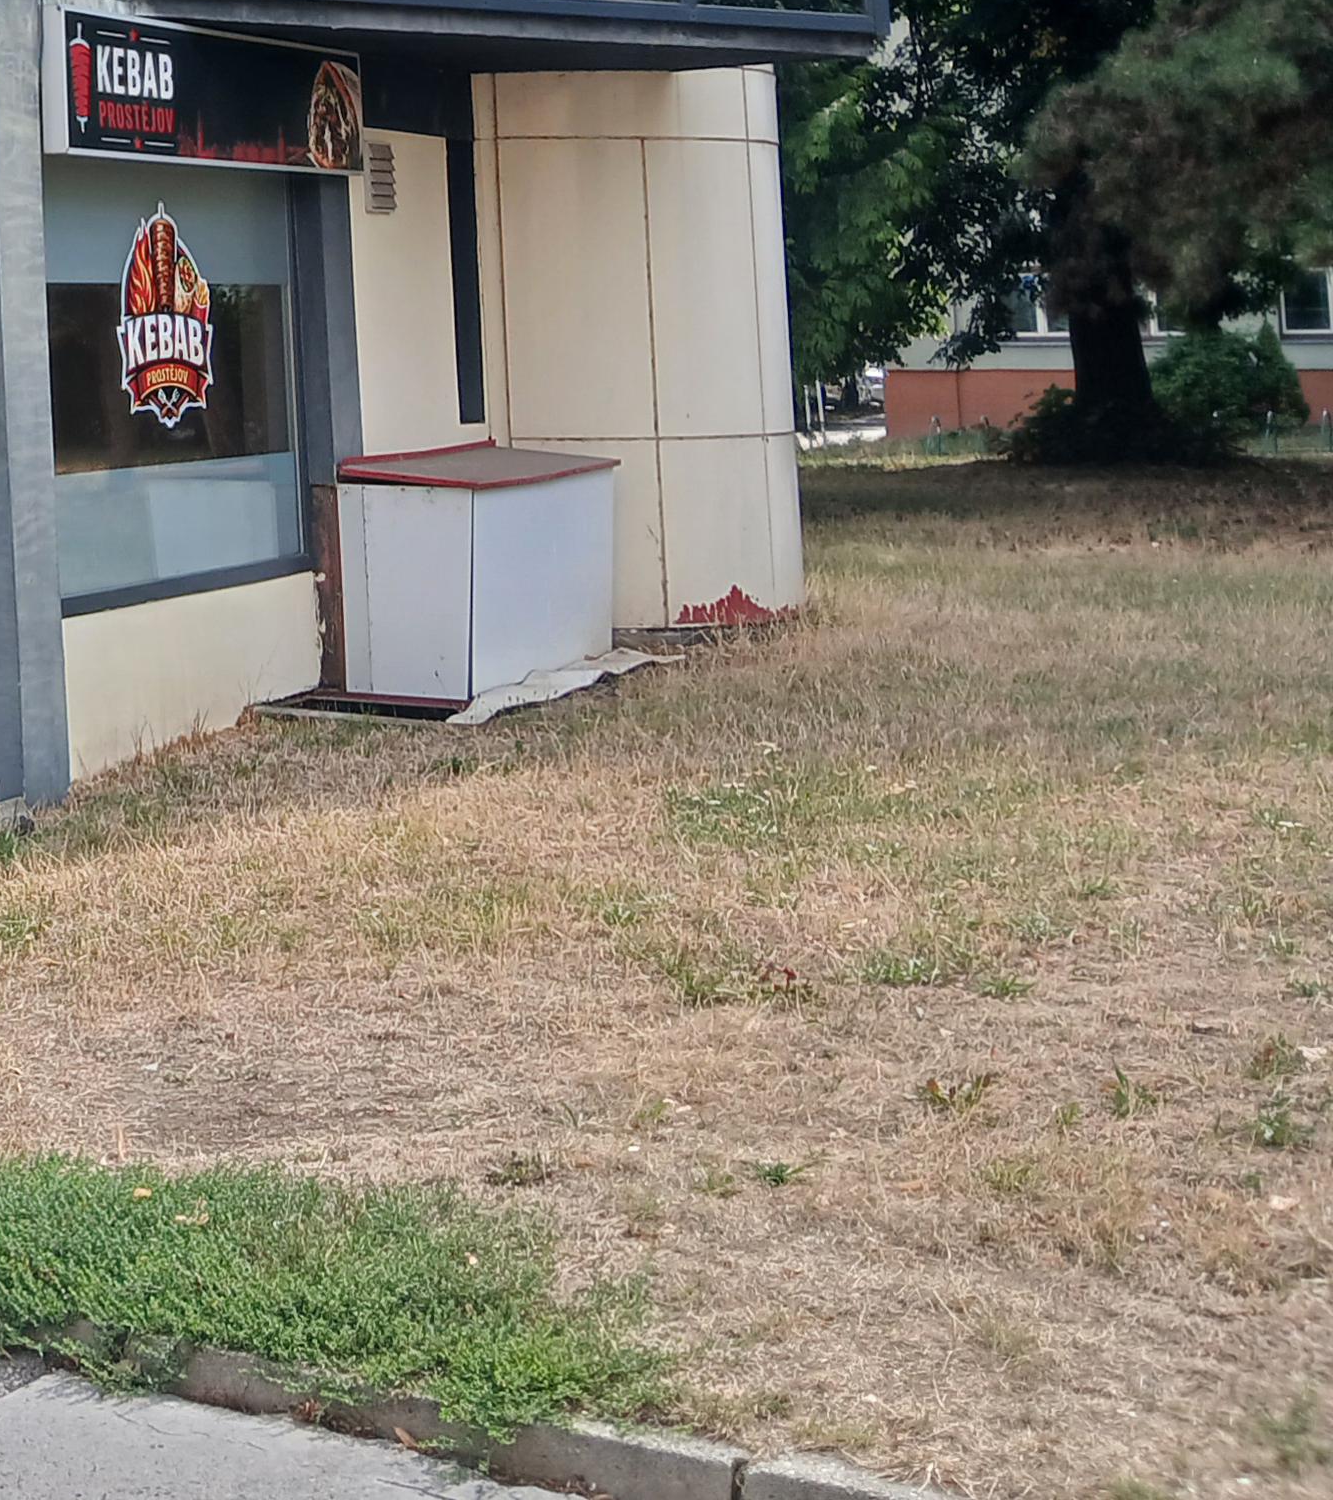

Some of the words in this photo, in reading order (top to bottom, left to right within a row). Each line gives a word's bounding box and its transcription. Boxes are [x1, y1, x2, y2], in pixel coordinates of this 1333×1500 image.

[96, 44, 174, 100] KEBAB
[98, 100, 175, 133] PROSTĚJOV
[126, 314, 204, 370] KEBAB
[146, 364, 189, 386] PROSTĚJOV
